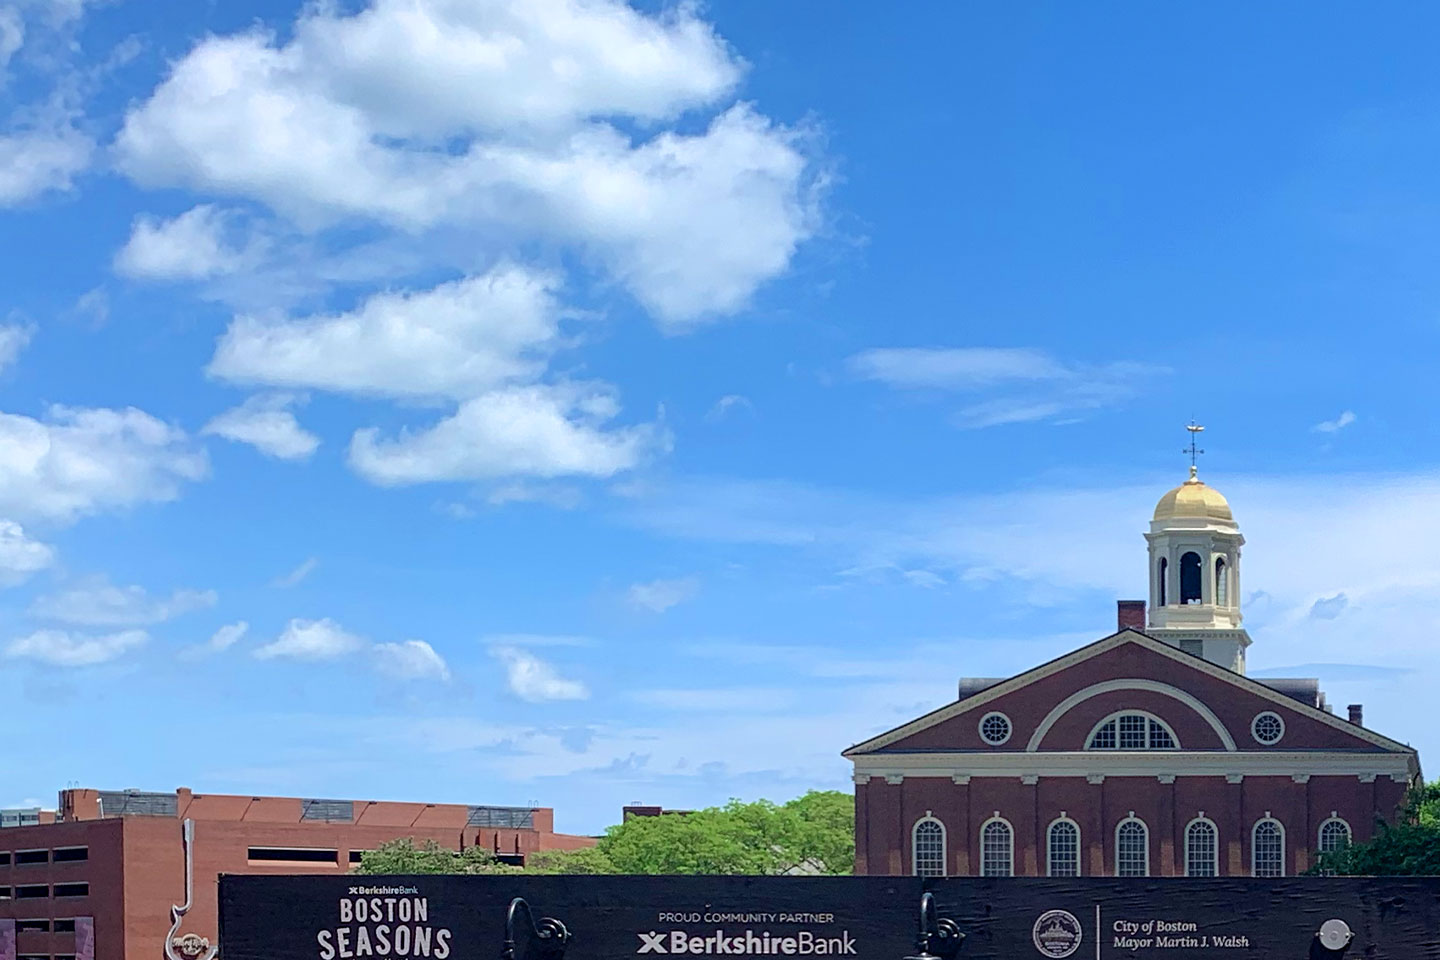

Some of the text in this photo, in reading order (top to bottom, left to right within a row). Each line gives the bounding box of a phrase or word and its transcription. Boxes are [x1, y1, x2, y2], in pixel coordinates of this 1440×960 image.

[358, 886, 418, 895] BerkshireBank
[340, 898, 427, 922] BOSTON
[659, 912, 834, 923] PROUD COMMUNITY PARTNER
[1113, 920, 1197, 935] City of Boston
[317, 925, 452, 960] SEASONS
[670, 930, 857, 955] BerkshireBank
[1113, 936, 1250, 951] Mayor Martin J. Walsh
